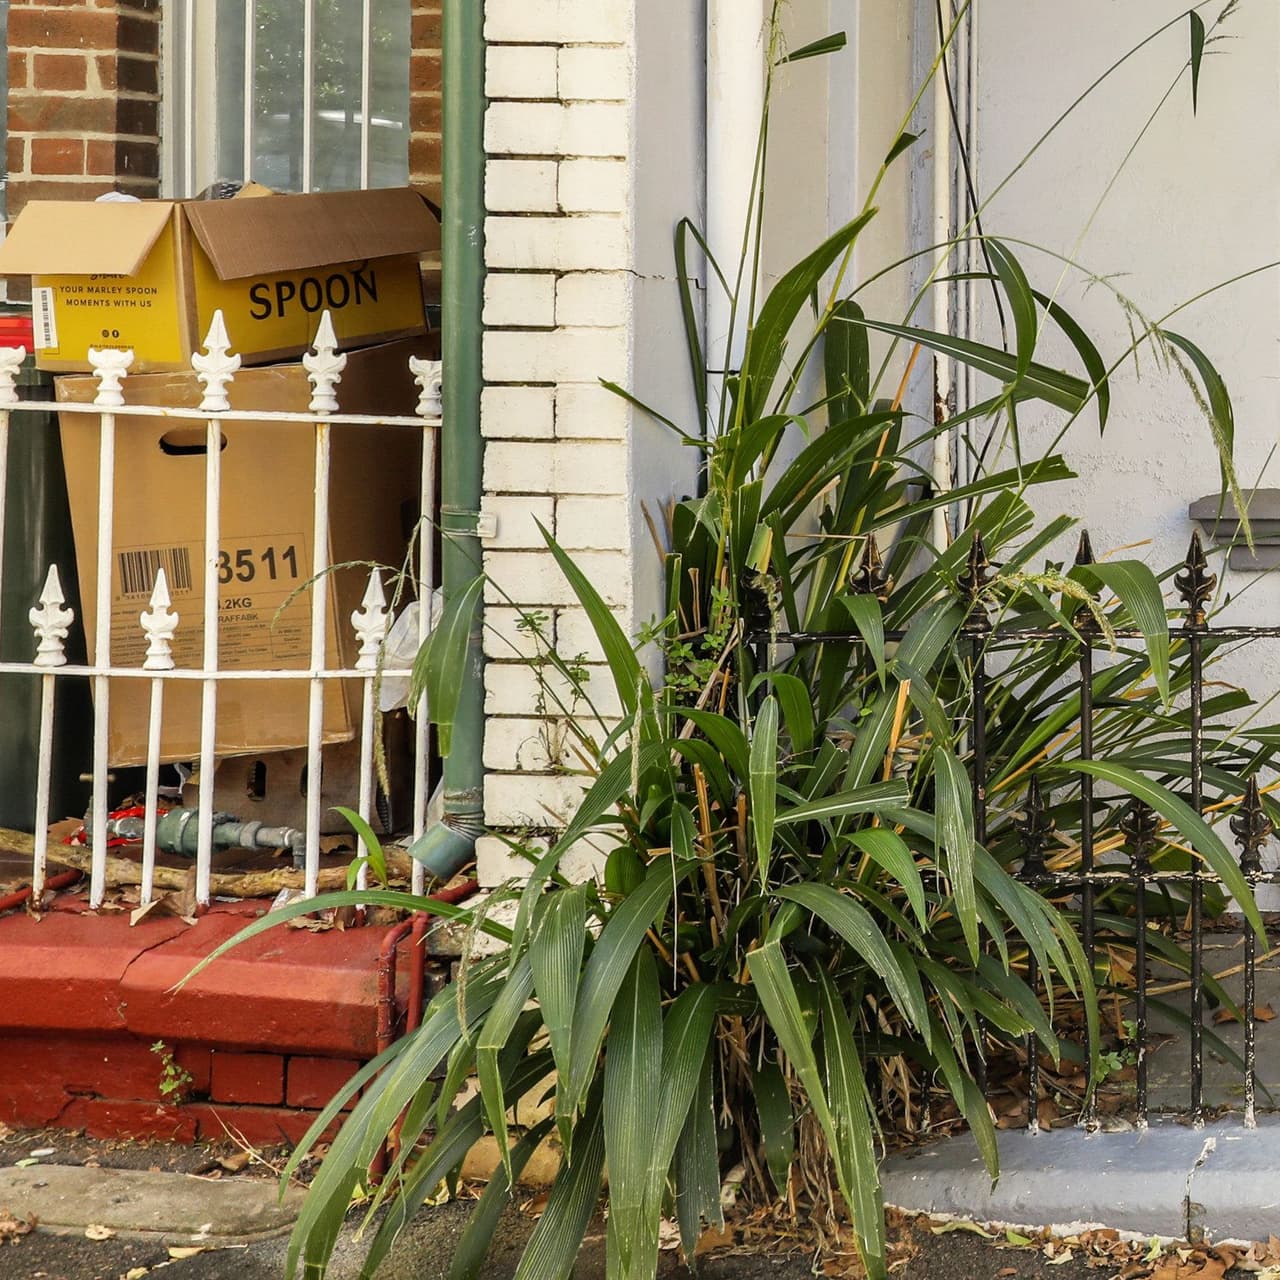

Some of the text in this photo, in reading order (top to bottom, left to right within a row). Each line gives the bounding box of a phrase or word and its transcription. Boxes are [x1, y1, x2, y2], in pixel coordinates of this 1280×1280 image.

[60, 285, 158, 295] YOUR MARLEY SPOON
[249, 271, 378, 320] SPOON
[66, 298, 152, 308] MOMENTS WITH US
